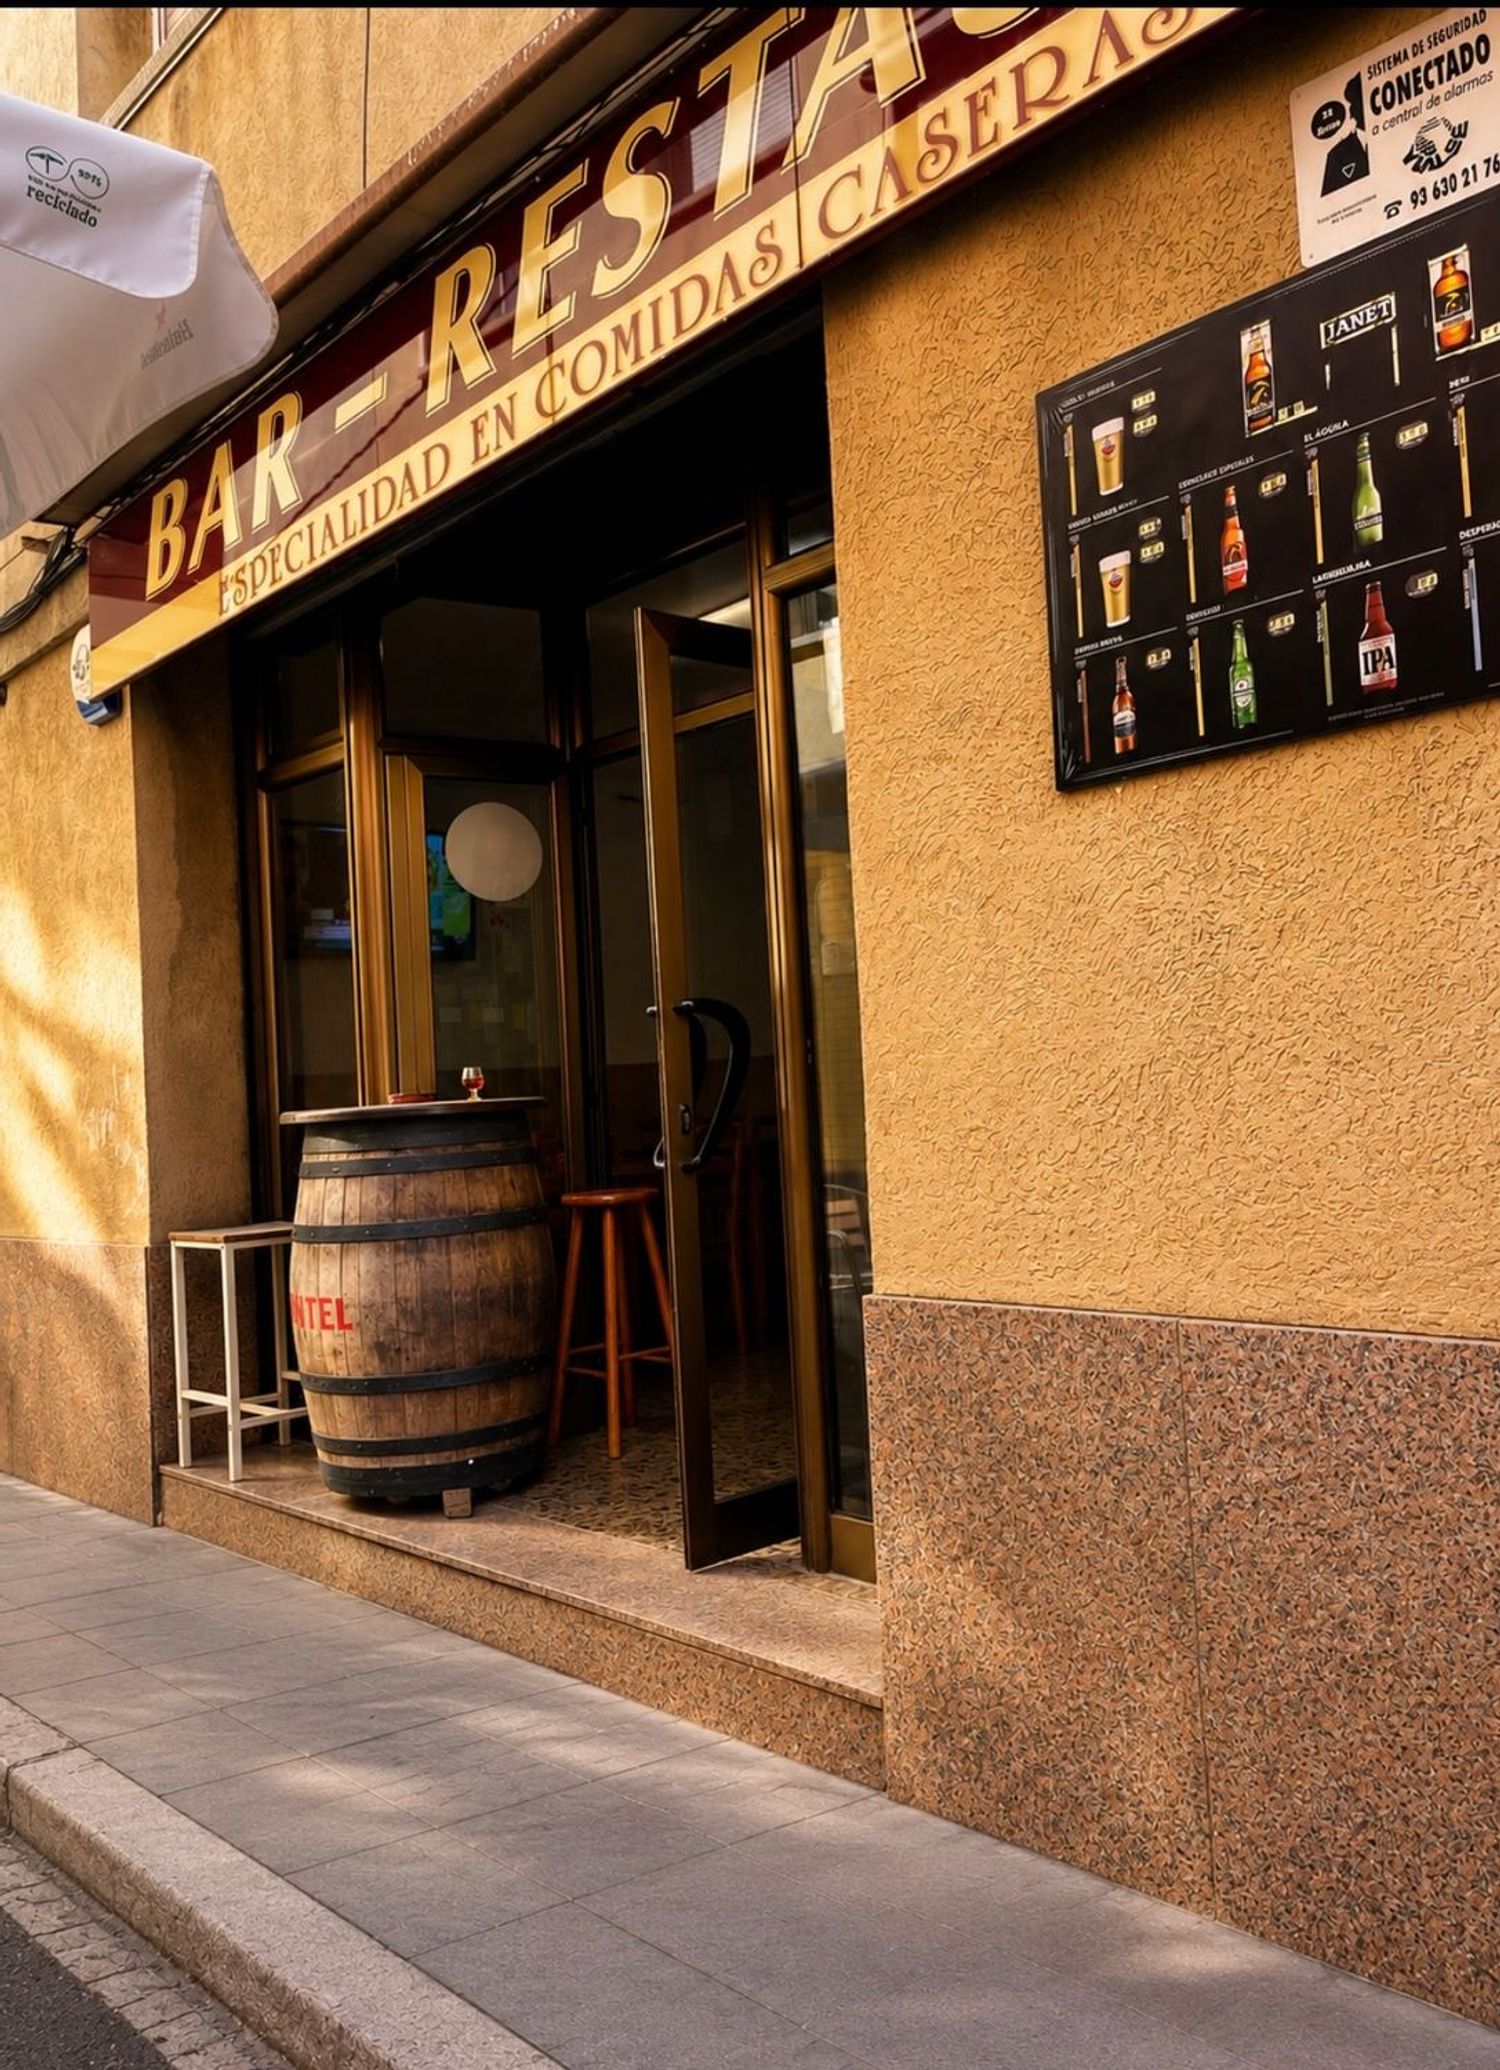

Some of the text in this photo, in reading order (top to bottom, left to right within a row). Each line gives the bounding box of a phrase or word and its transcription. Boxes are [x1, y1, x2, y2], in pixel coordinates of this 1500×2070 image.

[1367, 9, 1487, 80] SISTEMA DE SEGURIDAD
[1370, 33, 1490, 116] CONECTADO
[1382, 100, 1423, 131] central
[1426, 94, 1441, 110] de
[1444, 70, 1494, 102] alarmas
[26, 184, 98, 228] reciclado
[1410, 153, 1500, 210] 93 630 21 76
[145, 389, 303, 602] BAR
[425, 7, 1040, 418] RESTA
[218, 441, 450, 616] ESPECIALIDAD
[470, 392, 518, 465] EN
[534, 219, 784, 420] COMIDAS
[1361, 645, 1395, 675] IPA
